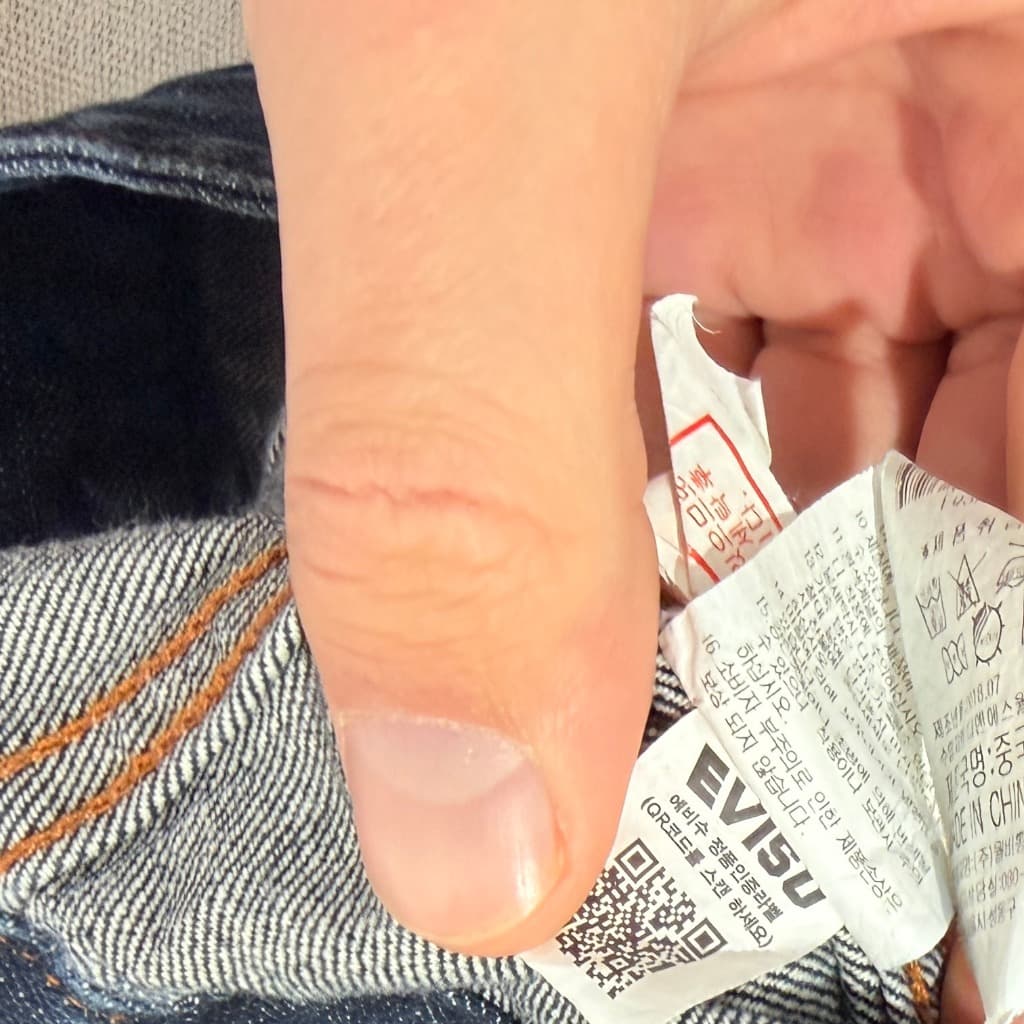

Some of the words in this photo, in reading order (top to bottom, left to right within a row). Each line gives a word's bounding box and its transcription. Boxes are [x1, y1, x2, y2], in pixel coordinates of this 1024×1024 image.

[737, 642, 801, 724] 하십시오.
[758, 634, 771, 651] 수
[700, 670, 730, 709] 보상
[724, 712, 759, 753] 되지
[752, 755, 810, 836] 않습니다.
[715, 662, 762, 714] 소비자
[759, 717, 813, 791] 부주의로
[808, 792, 842, 830] 인한
[837, 830, 903, 914] 제품손상은
[686, 743, 827, 909] EVISU
[699, 870, 732, 900] 스캔
[729, 898, 773, 948] 하세요)
[708, 837, 783, 923] 정품인증라벨
